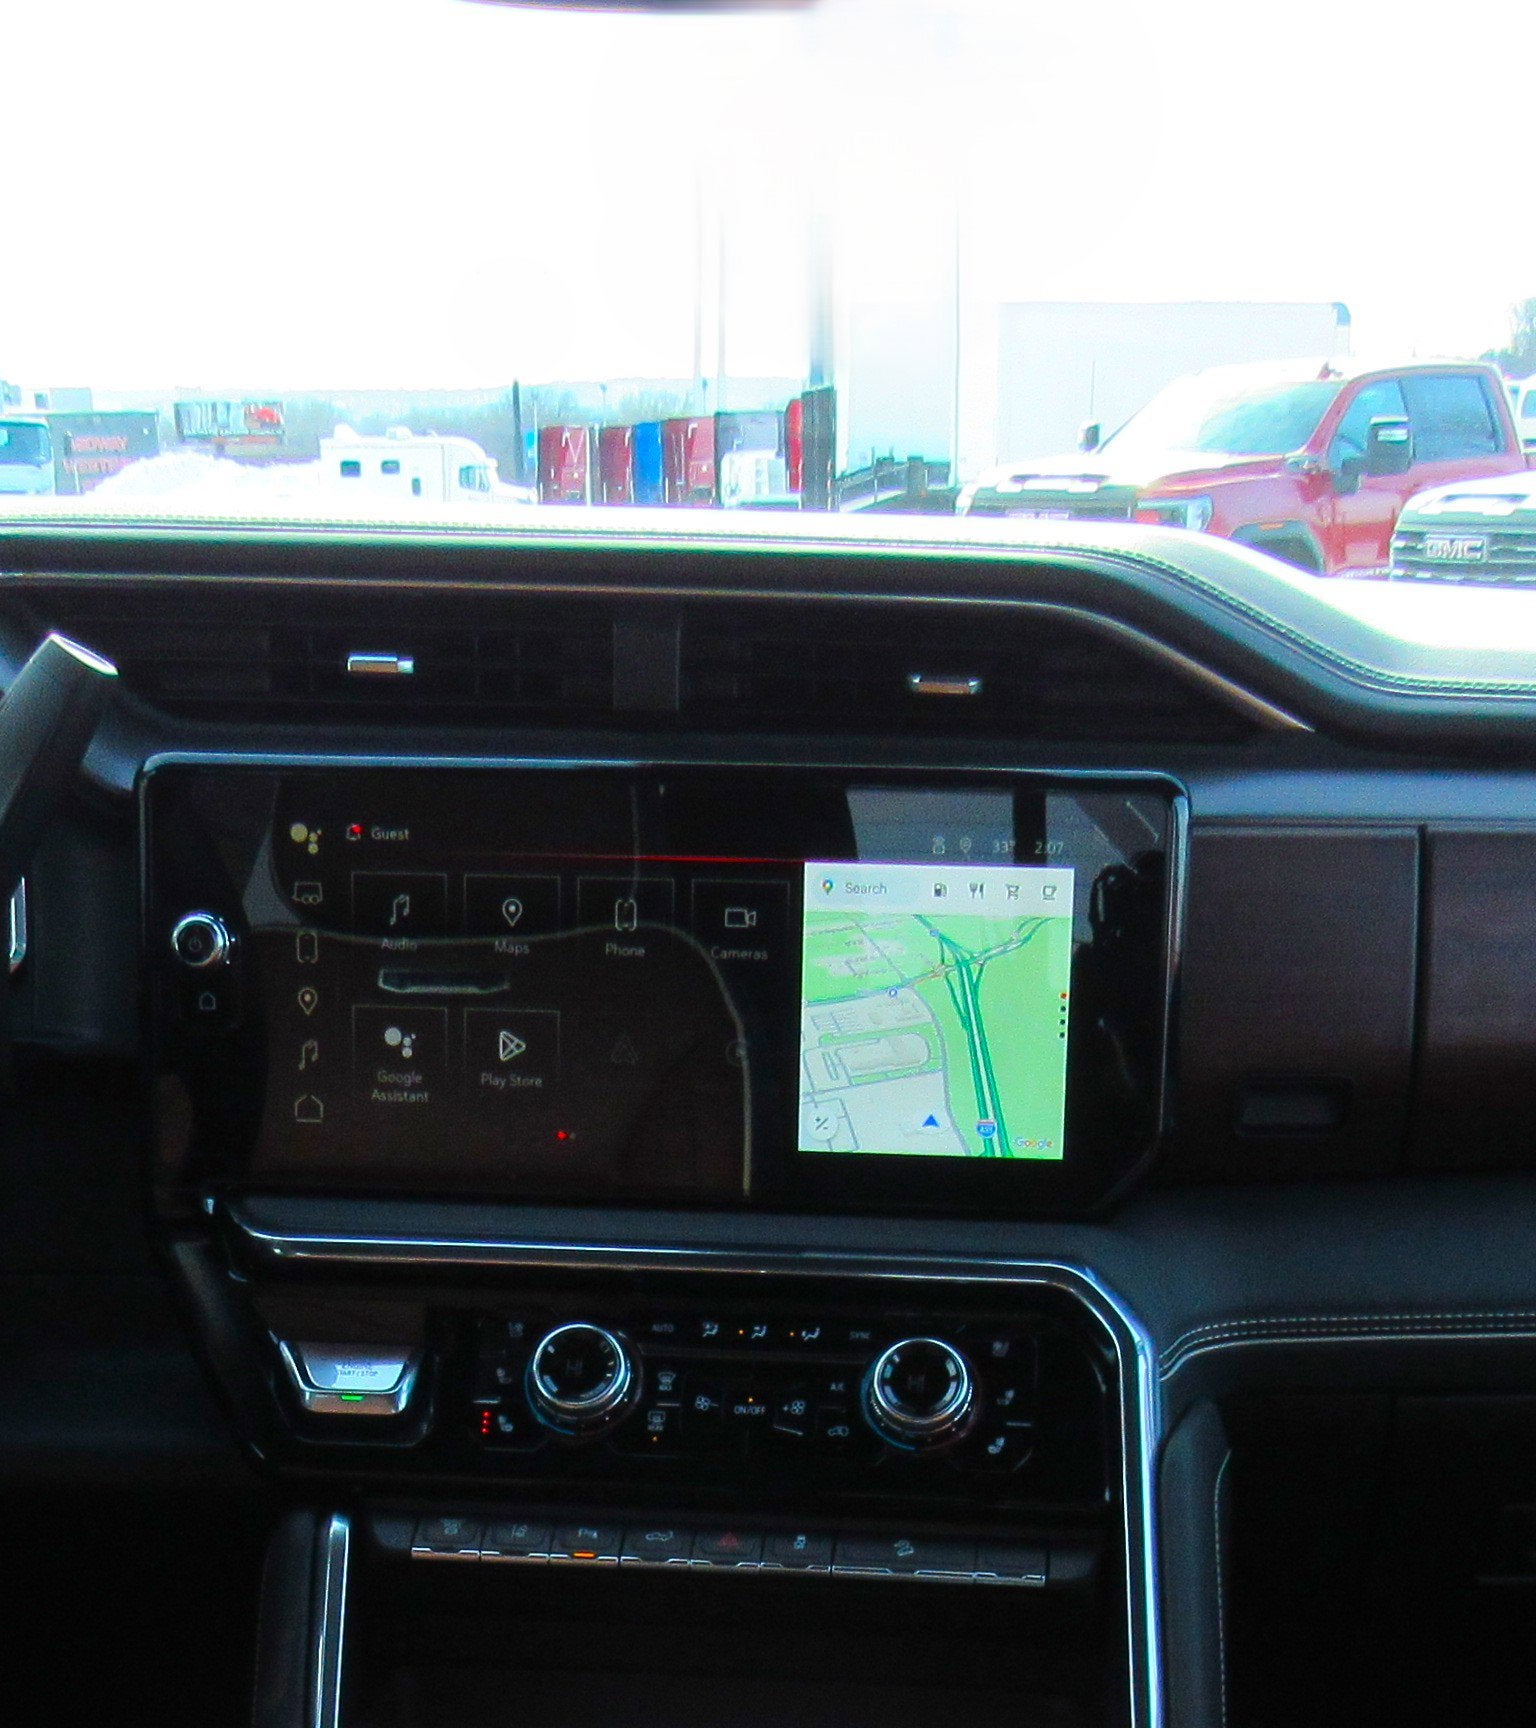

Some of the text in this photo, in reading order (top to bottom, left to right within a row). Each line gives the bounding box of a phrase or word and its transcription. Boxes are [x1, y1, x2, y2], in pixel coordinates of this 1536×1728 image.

[1425, 537, 1484, 561] GMC
[370, 825, 410, 842] Guest
[844, 881, 888, 897] Search
[380, 937, 418, 952] Audio
[494, 941, 531, 958] Maps
[604, 942, 647, 959] Phone
[709, 946, 769, 962] Cameras
[375, 1071, 424, 1089] Google
[480, 1073, 544, 1090] Play Store
[370, 1088, 430, 1104] Assistant
[1014, 1136, 1054, 1150] Google
[733, 1404, 767, 1416] ON/OFF
